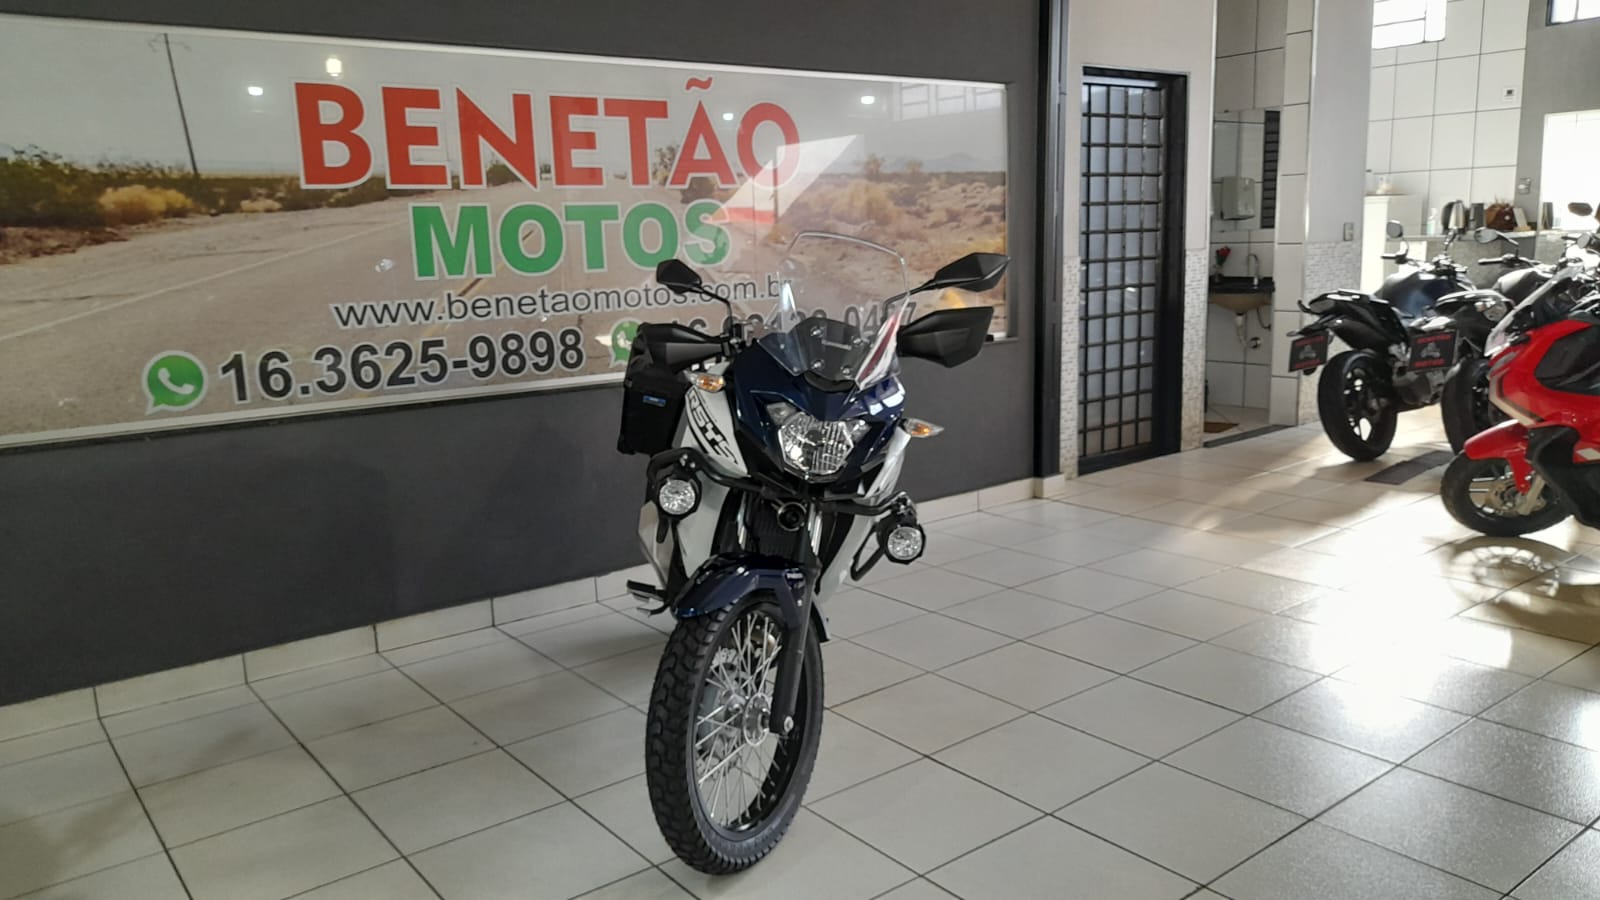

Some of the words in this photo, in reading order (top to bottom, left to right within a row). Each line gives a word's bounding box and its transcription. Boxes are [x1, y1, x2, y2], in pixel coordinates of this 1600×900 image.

[294, 76, 800, 190] BENETÃO
[411, 201, 730, 281] MOTOS
[220, 328, 585, 402] 16.3625-9898
